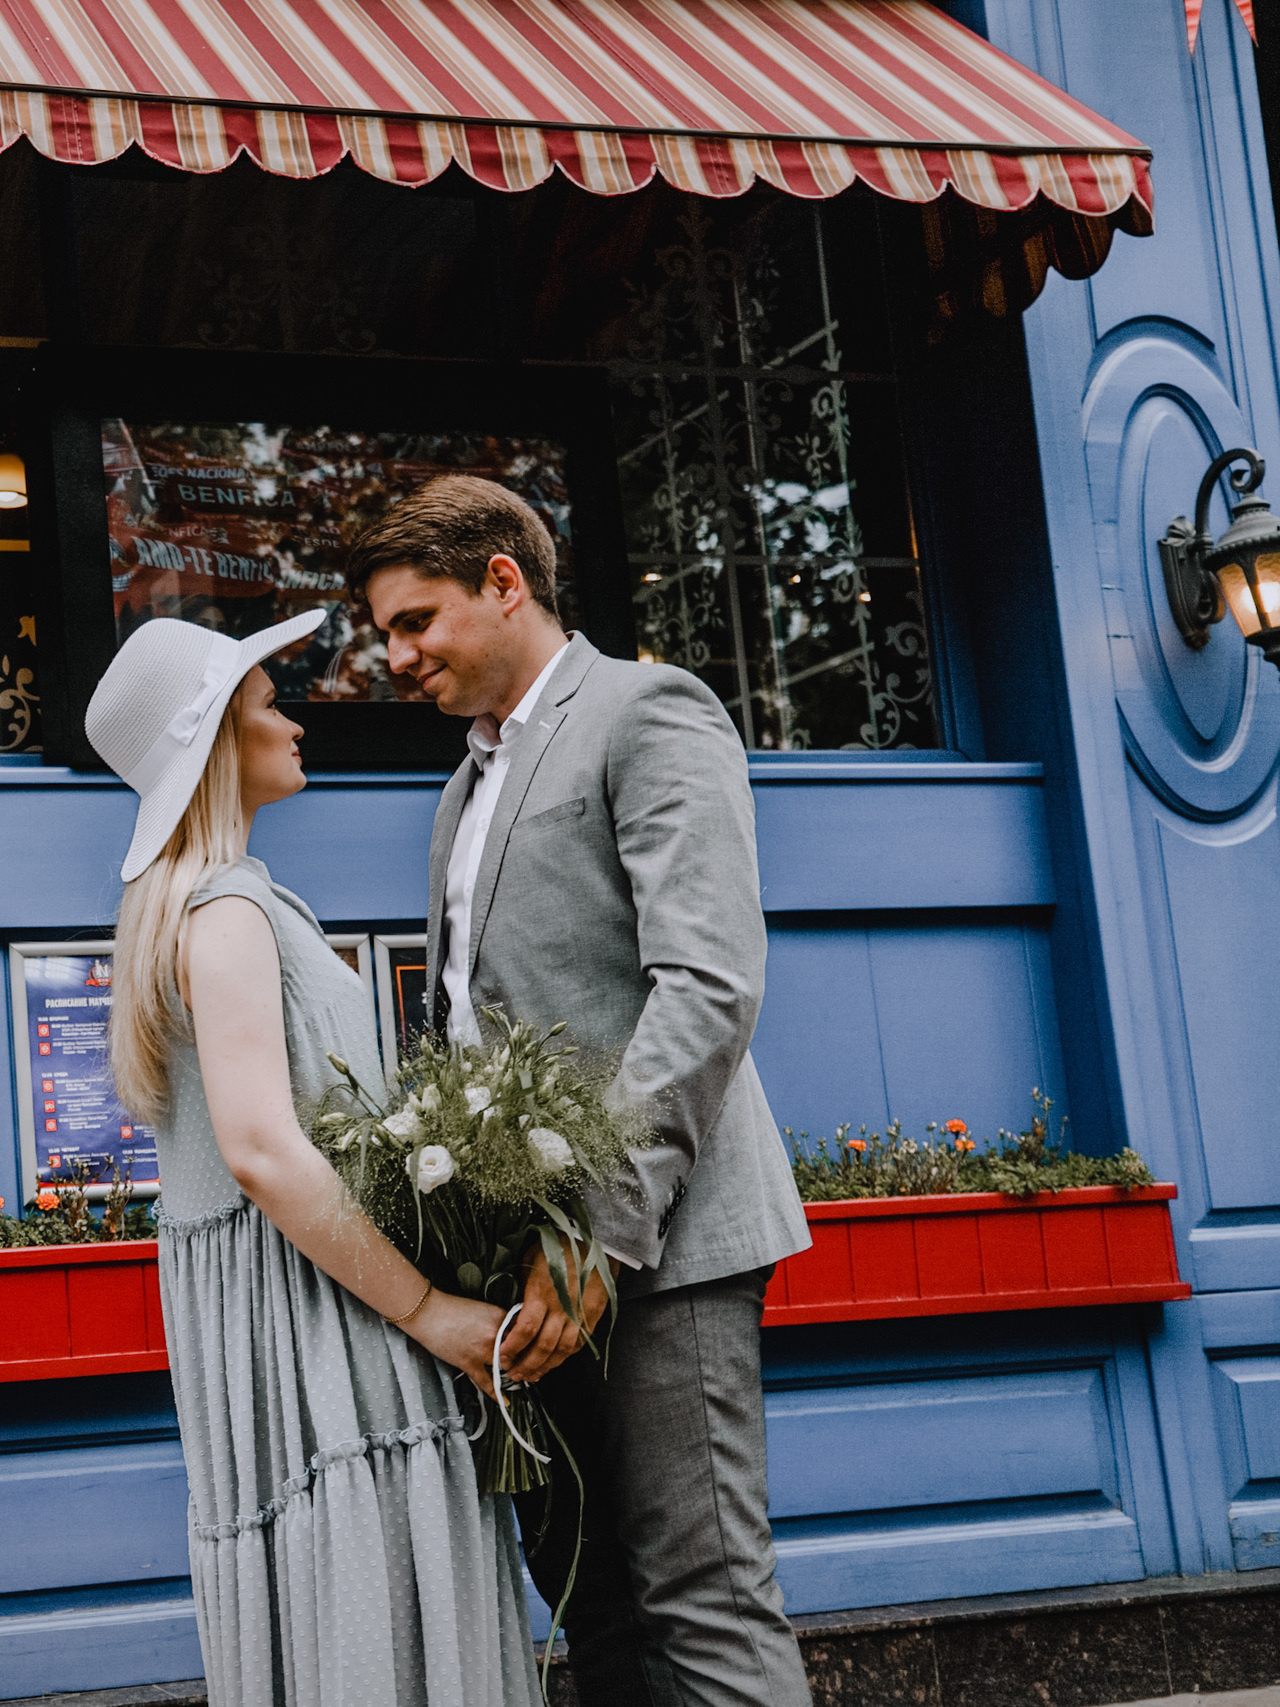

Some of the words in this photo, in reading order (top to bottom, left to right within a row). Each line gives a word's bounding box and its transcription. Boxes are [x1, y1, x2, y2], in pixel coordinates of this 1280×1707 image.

[186, 467, 248, 480] NACIONA
[131, 534, 215, 577] AMO-TE
[212, 549, 275, 584] BENFIC
[88, 995, 114, 1007] МАТЧЕ
